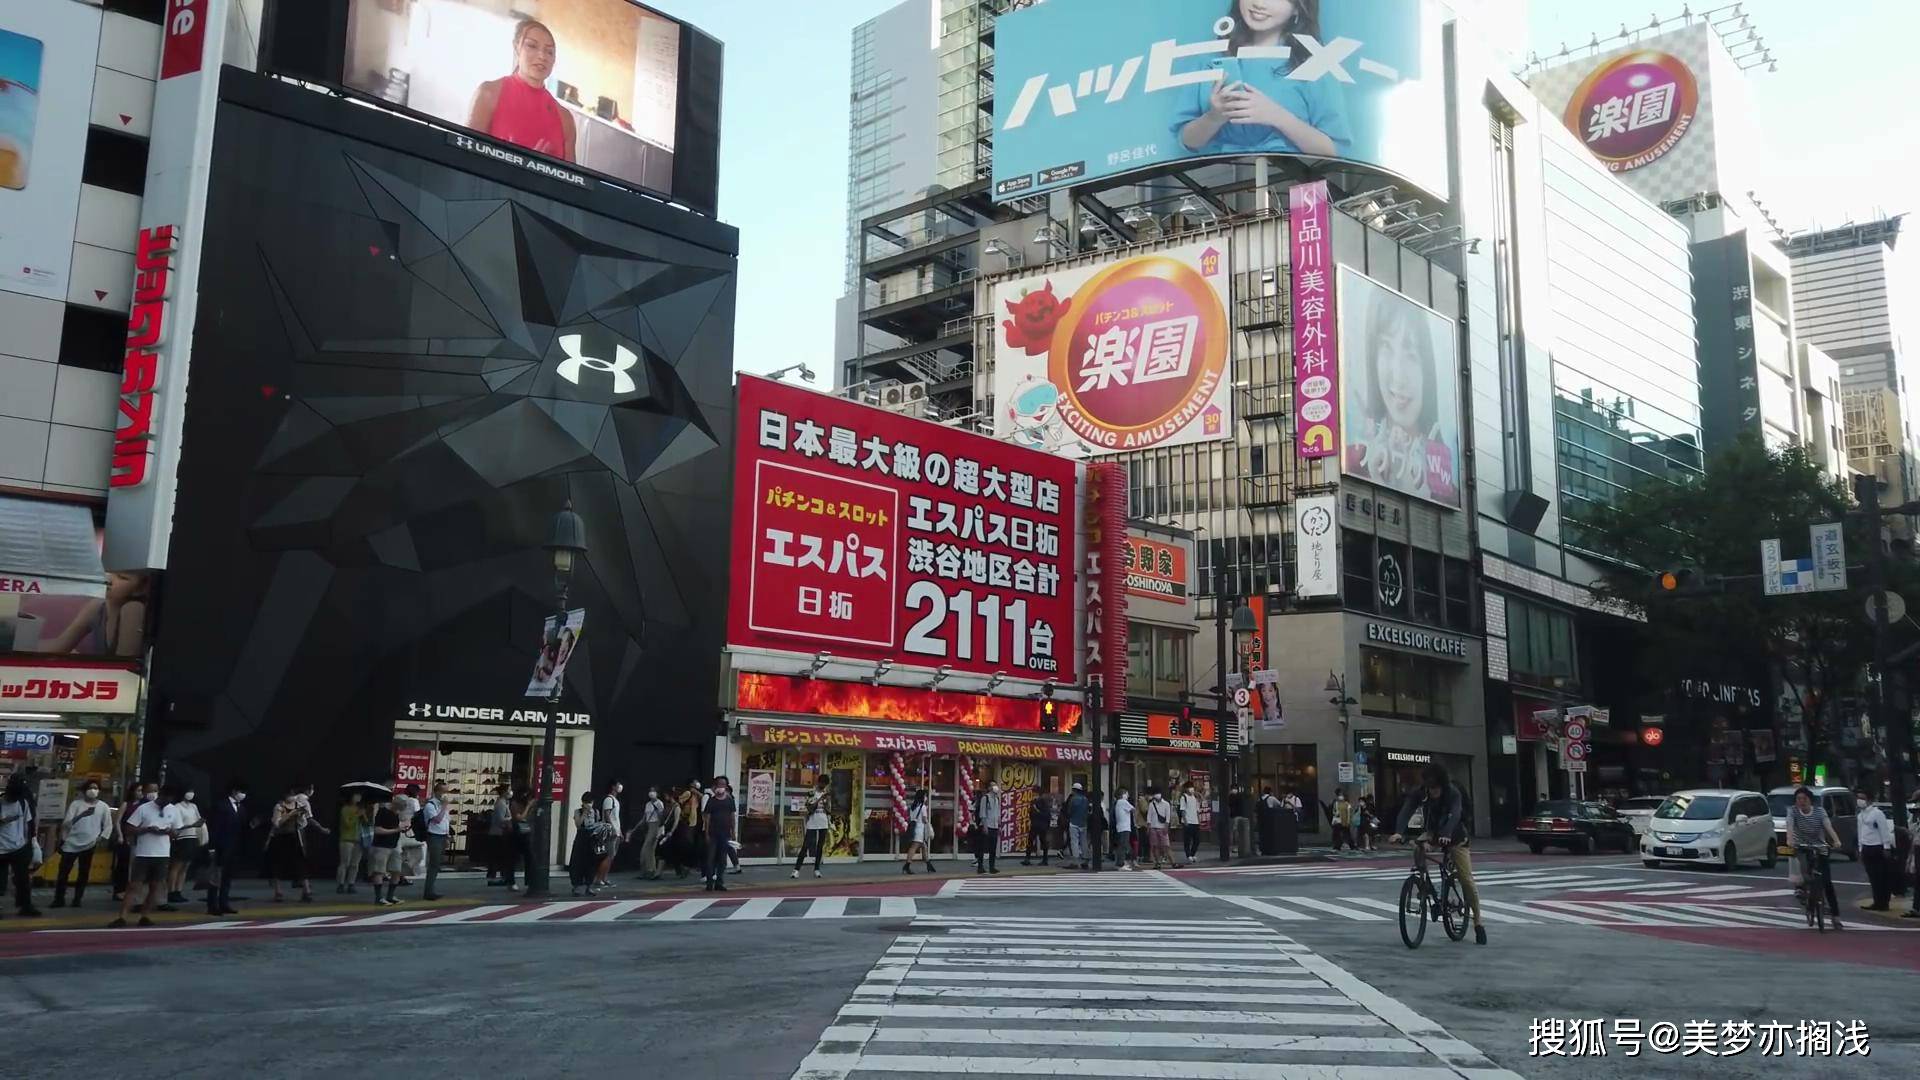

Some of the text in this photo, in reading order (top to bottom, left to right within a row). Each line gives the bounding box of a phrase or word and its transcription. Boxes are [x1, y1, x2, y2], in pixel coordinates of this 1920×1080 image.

[1586, 82, 1676, 142] 楽園
[1624, 113, 1692, 171] AMUSEMENT
[475, 143, 586, 186] UNDER ARMOUR
[1298, 217, 1329, 374] 品川美容外科
[1076, 315, 1199, 393] 楽園
[1732, 285, 1757, 421] 渋東シネタ
[1057, 368, 1220, 449] EXCITING AMUSEMENT
[758, 409, 1060, 515] 日本最大級の超大型店
[766, 485, 889, 527] パチンコ&スロット
[907, 494, 1059, 557] エスパス日拓
[762, 528, 888, 582] エスパス
[907, 536, 1060, 598] 渋谷地区合計
[1122, 574, 1173, 595] OSHINOYA
[797, 585, 854, 622] 日拓
[1368, 623, 1431, 649] EXCELSIOR
[1028, 656, 1058, 672] OVER
[436, 705, 504, 721] UNDER
[1238, 690, 1246, 704] 3
[1169, 720, 1202, 738] 吉家
[1169, 739, 1201, 749] YOSHINOYA
[957, 740, 1014, 757] PACHINKO
[1020, 745, 1048, 758] SLOT
[1056, 747, 1093, 761] ESPAC
[1387, 752, 1414, 762] EXCELSIOR
[1001, 763, 1036, 792] 990
[1002, 791, 1014, 806] 3F
[1002, 808, 1014, 822] 2F
[1001, 822, 1014, 837] 1F
